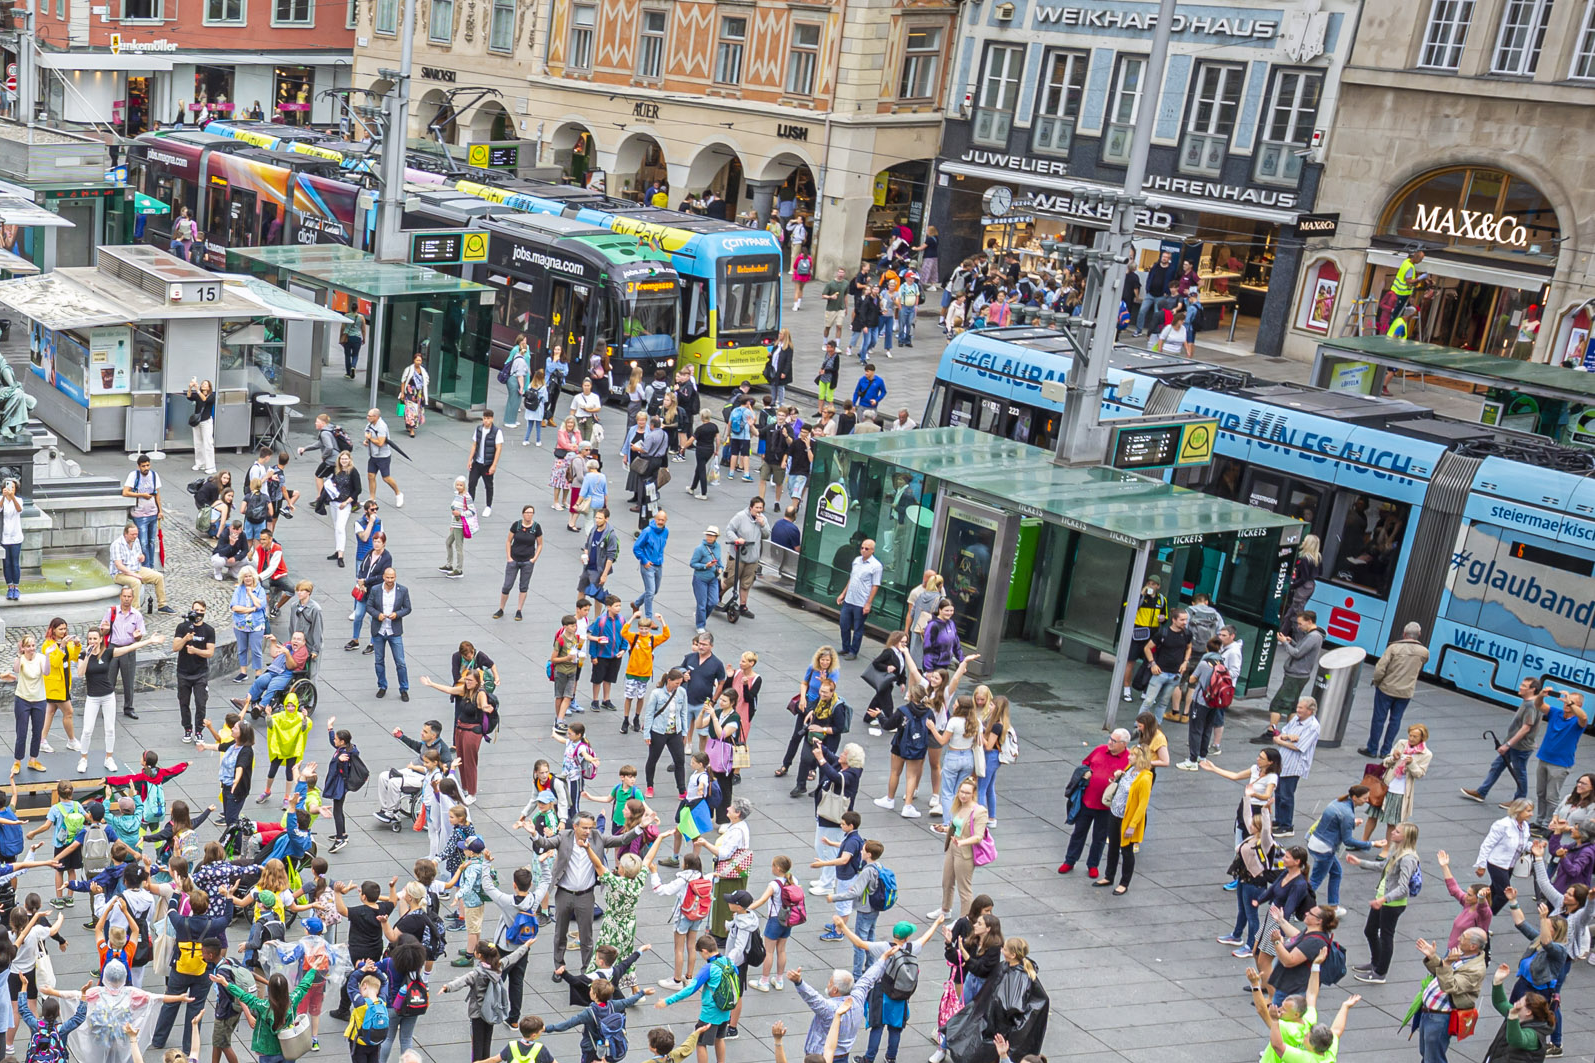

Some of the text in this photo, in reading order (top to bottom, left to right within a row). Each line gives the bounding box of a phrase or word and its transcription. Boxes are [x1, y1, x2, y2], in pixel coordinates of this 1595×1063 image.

[119, 38, 178, 52] unkemöller
[421, 66, 457, 83] SWAROVSKI
[777, 124, 809, 142] LUSH
[961, 149, 1067, 176] JUWELIER
[1026, 191, 1173, 230] WEIKHRD
[1412, 203, 1528, 247] MAX&Co.
[512, 244, 584, 276] jobs.magna.com
[196, 286, 216, 302] 15
[627, 282, 634, 293] 3
[606, 347, 613, 357] 3
[1008, 406, 1020, 416] 223
[1046, 418, 1053, 432] 6
[1299, 431, 1333, 464] ES
[1173, 534, 1203, 545] TICKETS
[1237, 528, 1267, 538] TICKETS
[1517, 543, 1526, 558] 6
[1274, 562, 1289, 599] TICKETS
[1257, 630, 1274, 672] TICKETS
[1454, 628, 1485, 652] Wir
[1487, 643, 1519, 664] tun
[1522, 653, 1544, 671] es
